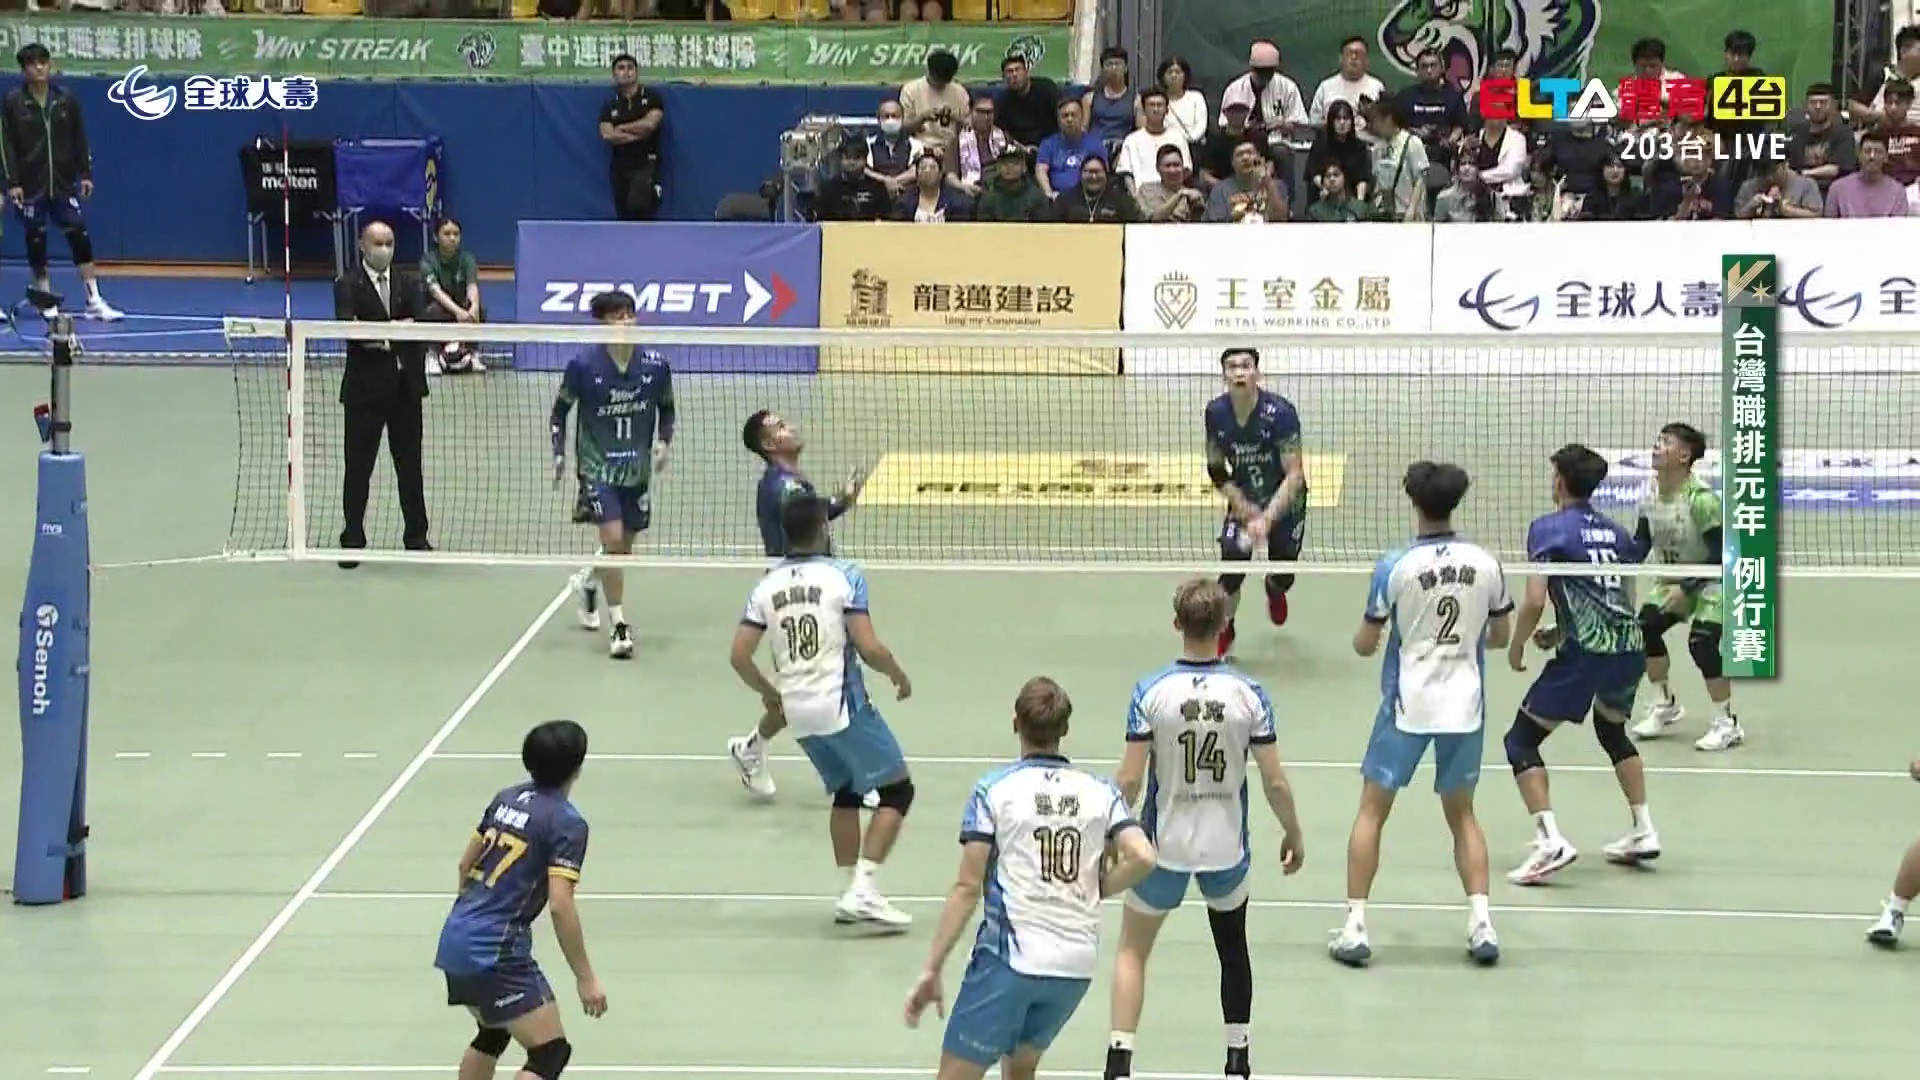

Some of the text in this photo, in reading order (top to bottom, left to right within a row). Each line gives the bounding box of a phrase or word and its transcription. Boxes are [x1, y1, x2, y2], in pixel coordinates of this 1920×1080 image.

[317, 37, 433, 61] STREAK
[914, 283, 1074, 314] 龍邁建設
[1216, 275, 1391, 312] 王室金屬
[1556, 280, 1722, 318] 全球人壽
[1215, 316, 1257, 329] METAL
[1264, 316, 1330, 329] WORKING
[614, 416, 633, 440] 11
[1437, 595, 1461, 645] 2
[32, 628, 54, 716] Senoh
[1177, 729, 1227, 784] 14
[1033, 826, 1081, 883] 10
